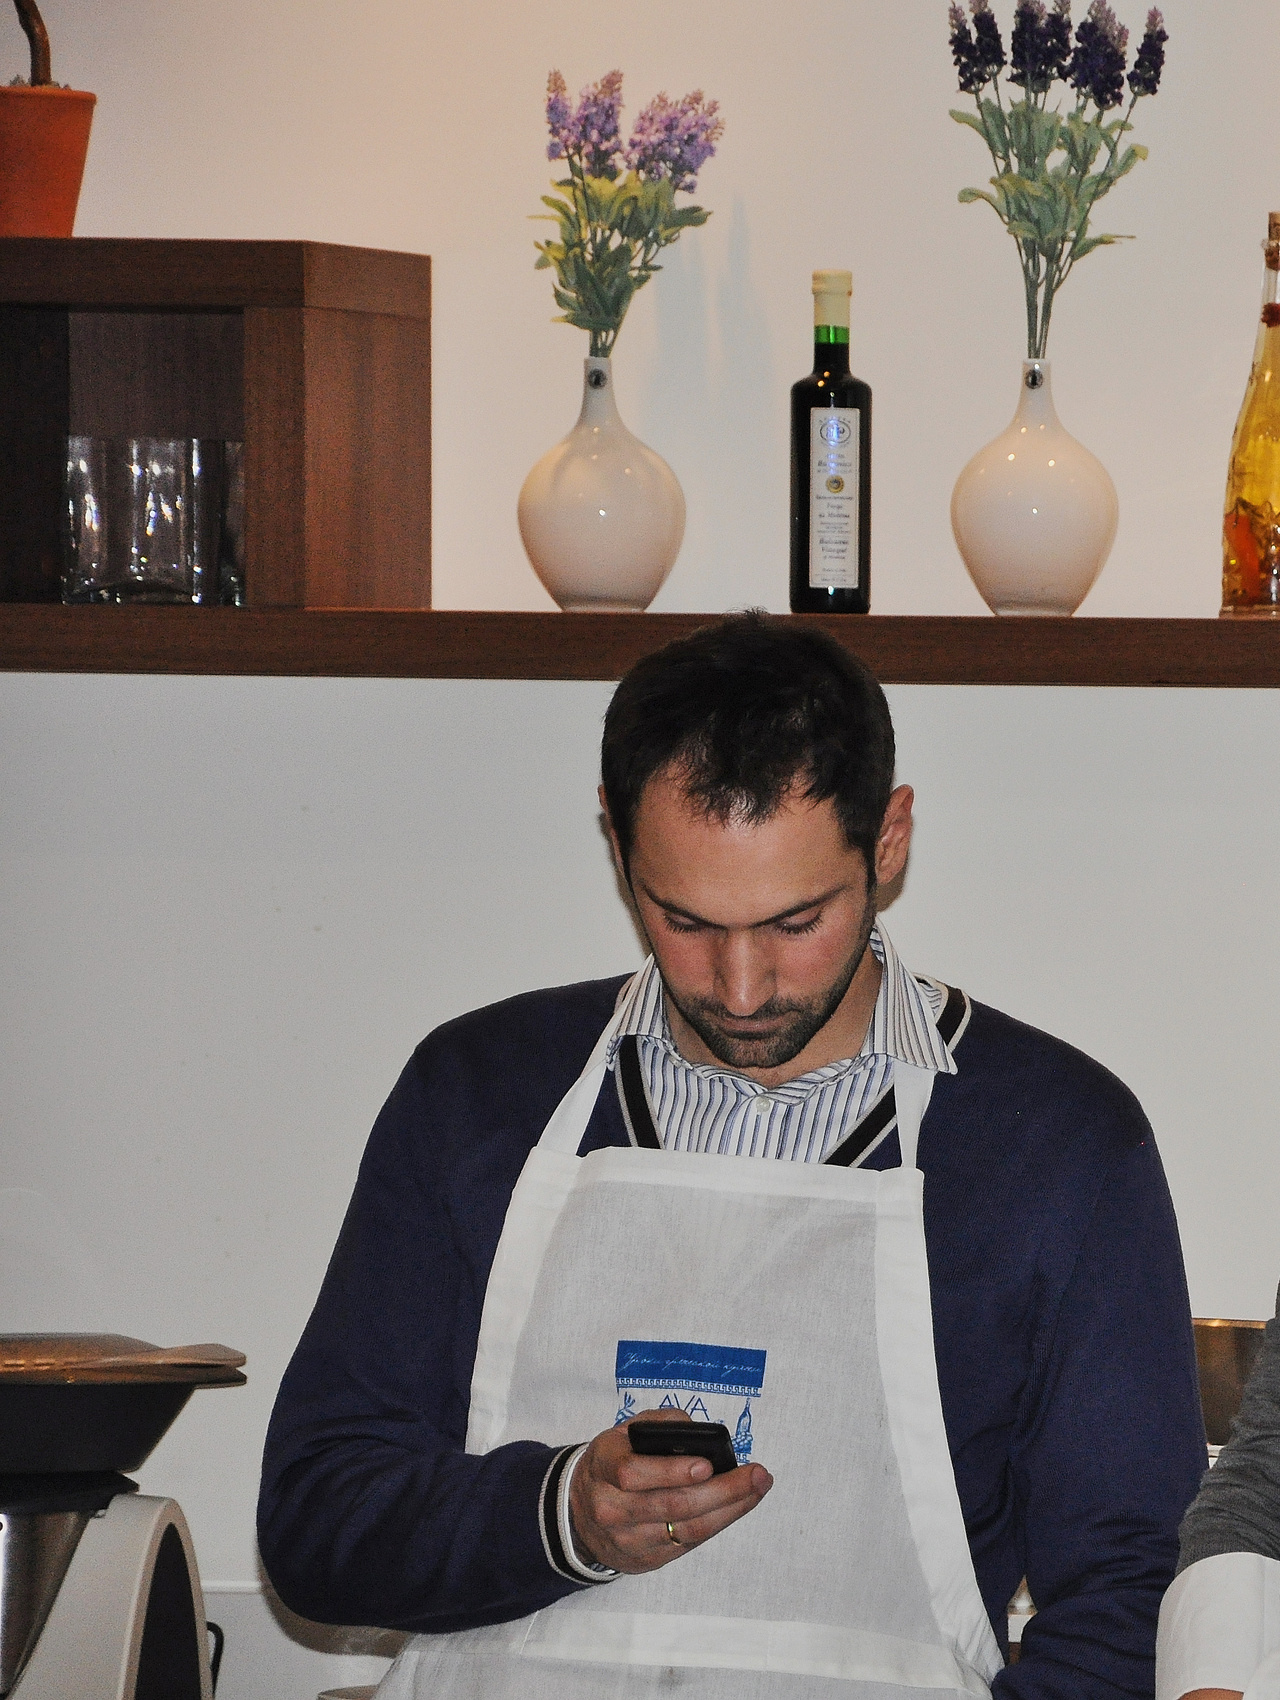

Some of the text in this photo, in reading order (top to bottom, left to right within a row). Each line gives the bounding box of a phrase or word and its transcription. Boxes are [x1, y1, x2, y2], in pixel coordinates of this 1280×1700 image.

[619, 1352, 660, 1371] Уроки
[662, 1358, 721, 1370] греческой
[659, 1393, 709, 1421] AVA
